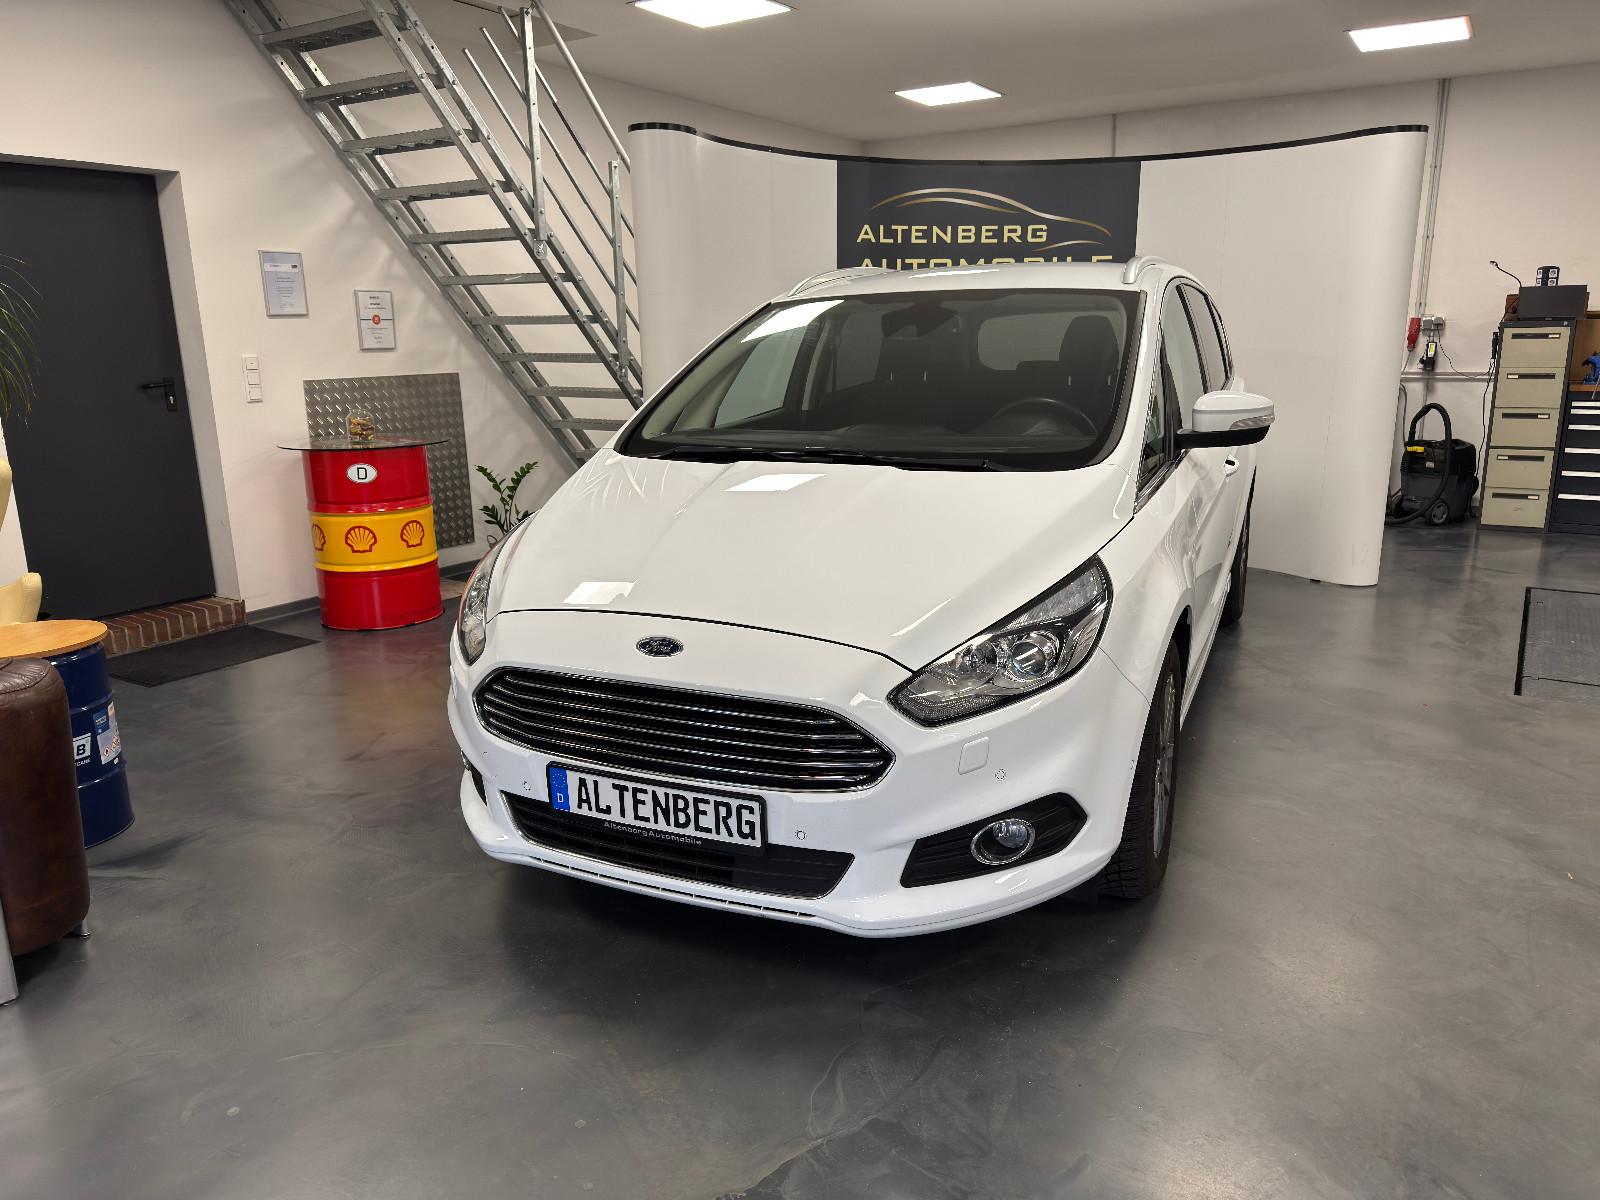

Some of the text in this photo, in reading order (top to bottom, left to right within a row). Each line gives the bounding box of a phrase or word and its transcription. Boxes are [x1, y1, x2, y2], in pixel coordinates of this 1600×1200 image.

[856, 224, 1048, 244] ALTENBERG
[357, 467, 368, 480] D
[576, 776, 757, 841] ALTENBERG
